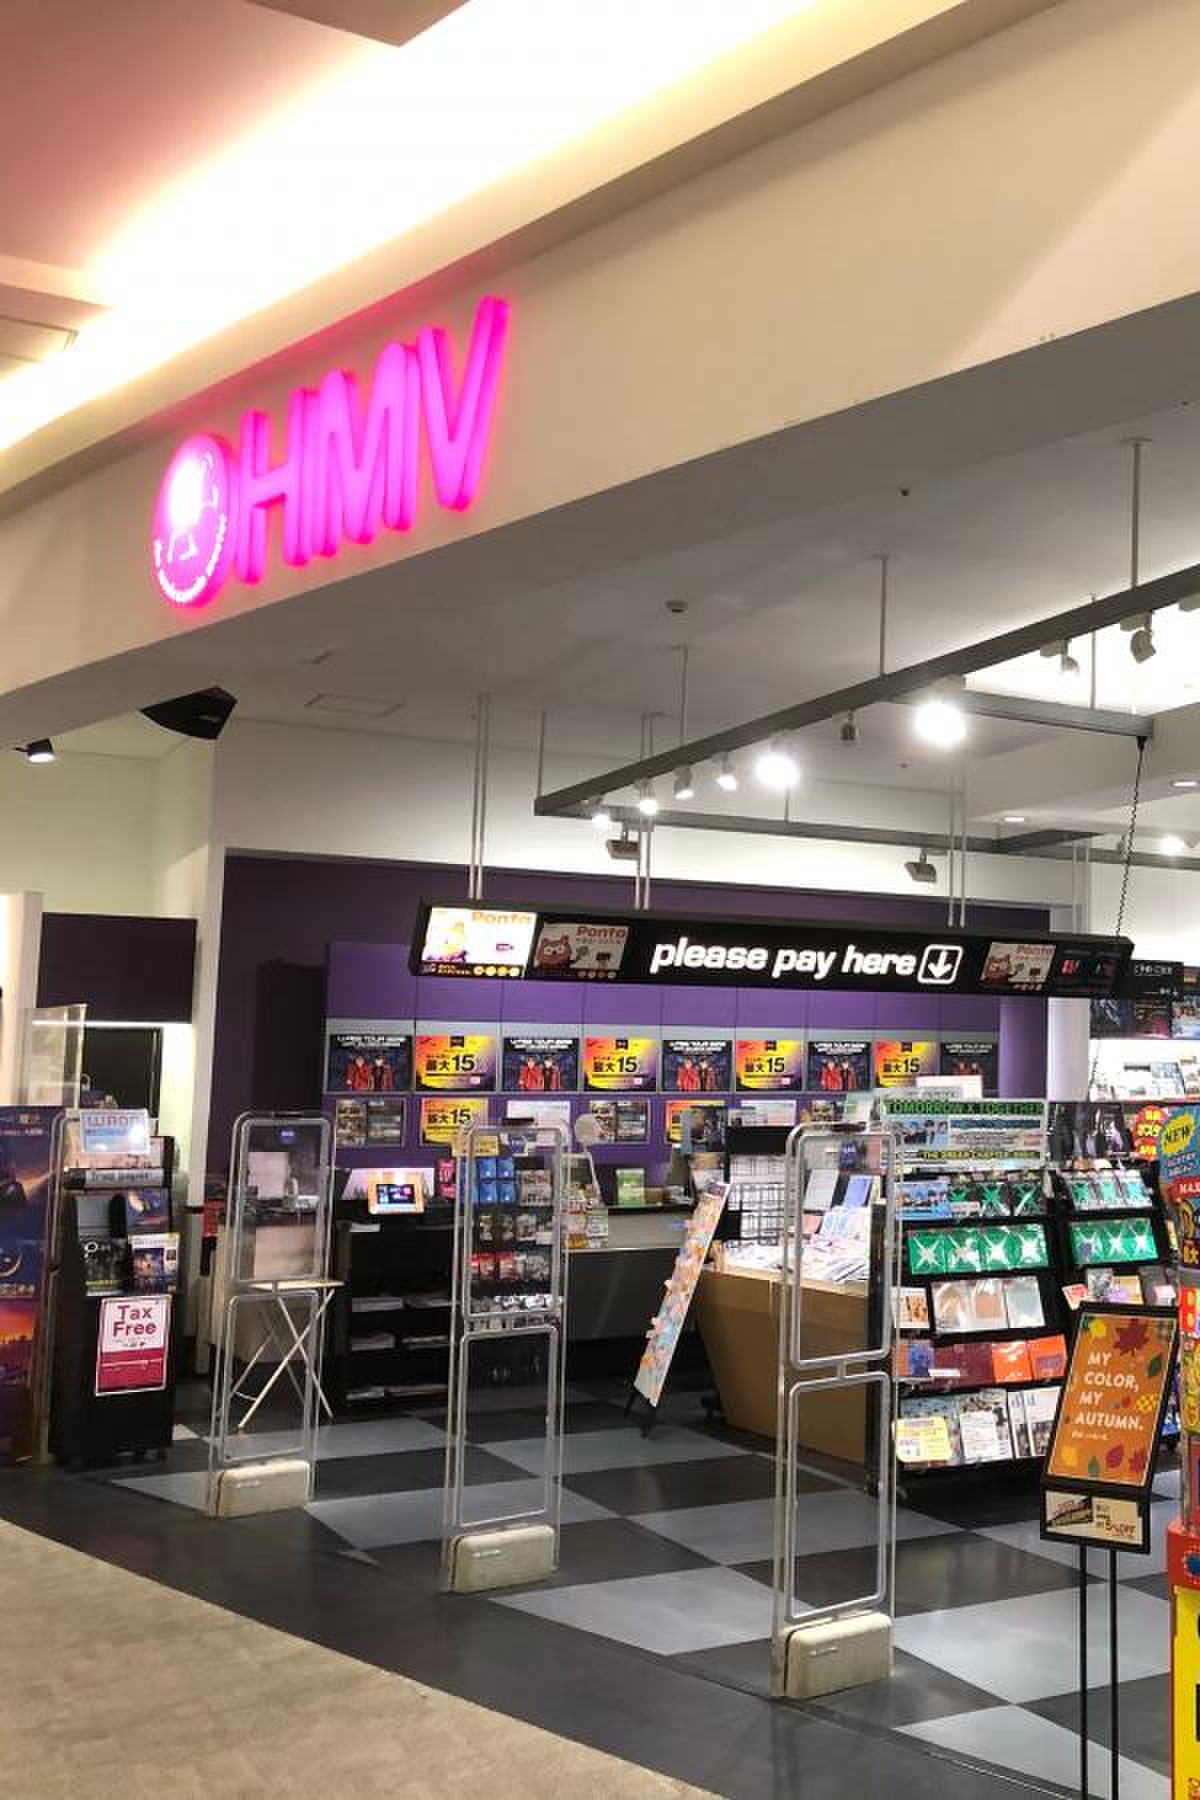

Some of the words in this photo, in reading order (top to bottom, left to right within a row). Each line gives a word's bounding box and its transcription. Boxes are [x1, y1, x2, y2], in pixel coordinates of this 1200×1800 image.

[236, 294, 512, 585] HMV
[471, 911, 532, 924] Ponta
[576, 926, 627, 938] Ponta
[650, 937, 769, 974] please
[771, 949, 836, 980] pay
[842, 945, 917, 975] here
[117, 1305, 152, 1321] Tax
[112, 1321, 157, 1337] Free
[1087, 1352, 1111, 1366] MY
[1083, 1371, 1140, 1392] COLOR,
[1079, 1392, 1103, 1406] MY
[1074, 1413, 1144, 1431] AUTUMN.
